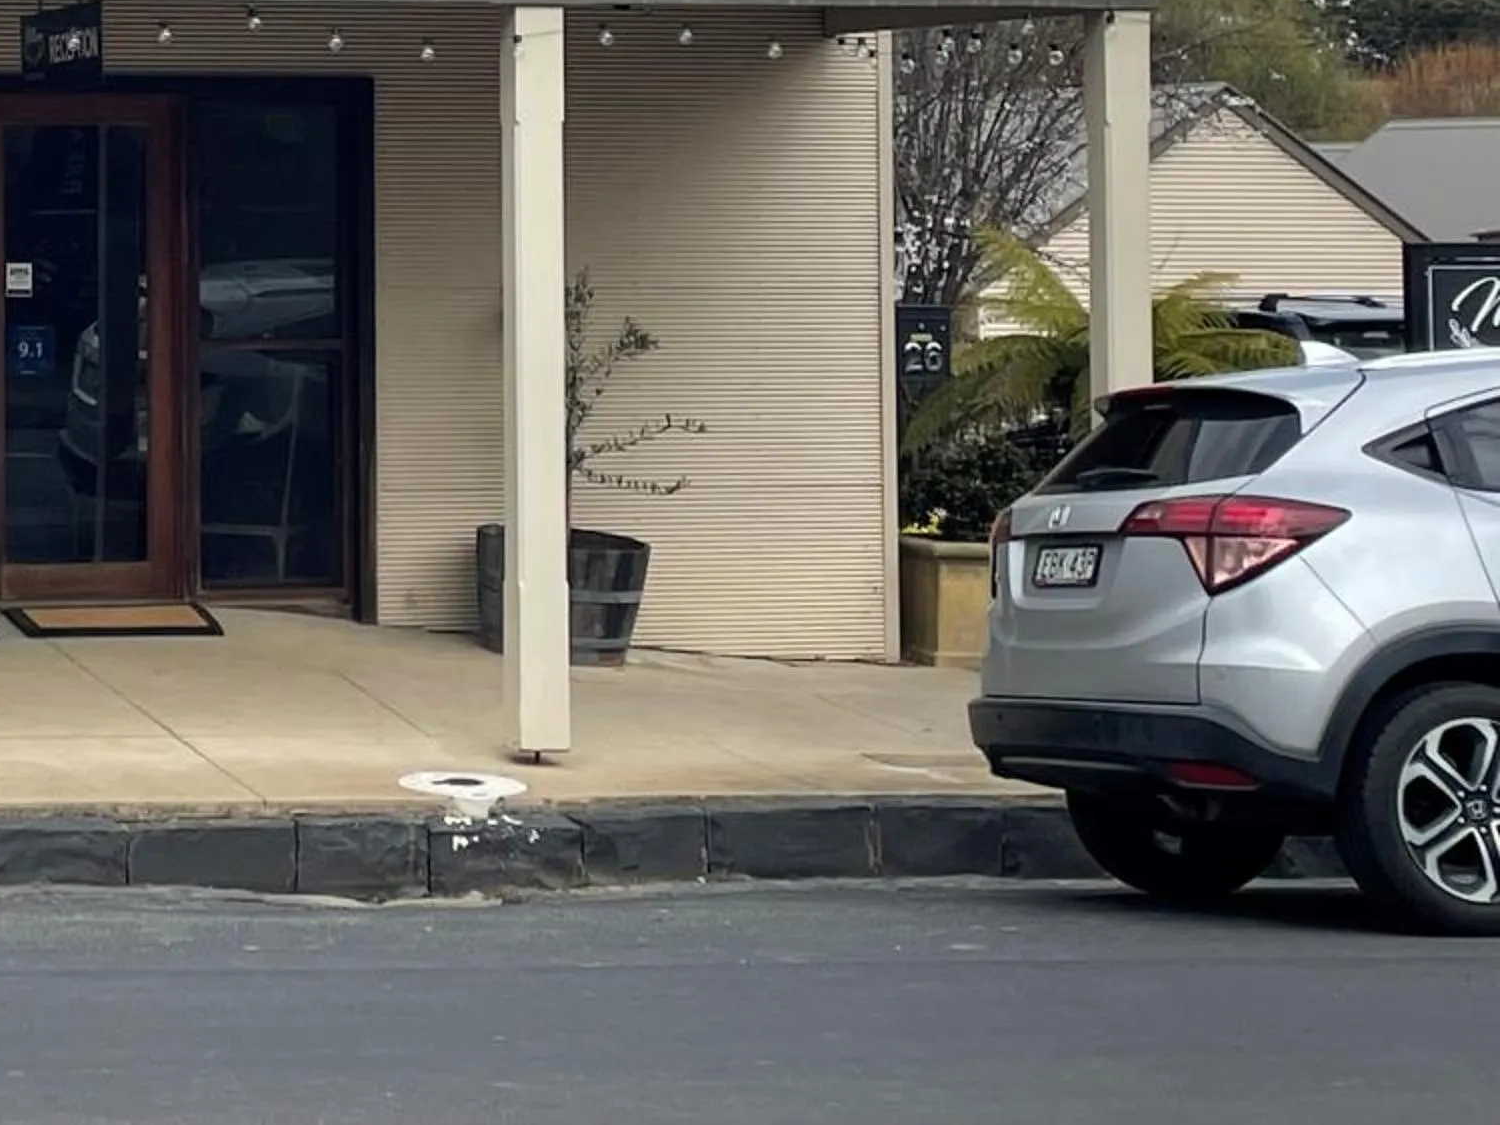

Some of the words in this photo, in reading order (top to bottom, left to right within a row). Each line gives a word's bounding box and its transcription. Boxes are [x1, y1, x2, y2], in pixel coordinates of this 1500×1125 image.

[48, 27, 99, 63] RECETION
[17, 340, 44, 359] 9.1
[903, 341, 943, 372] 26
